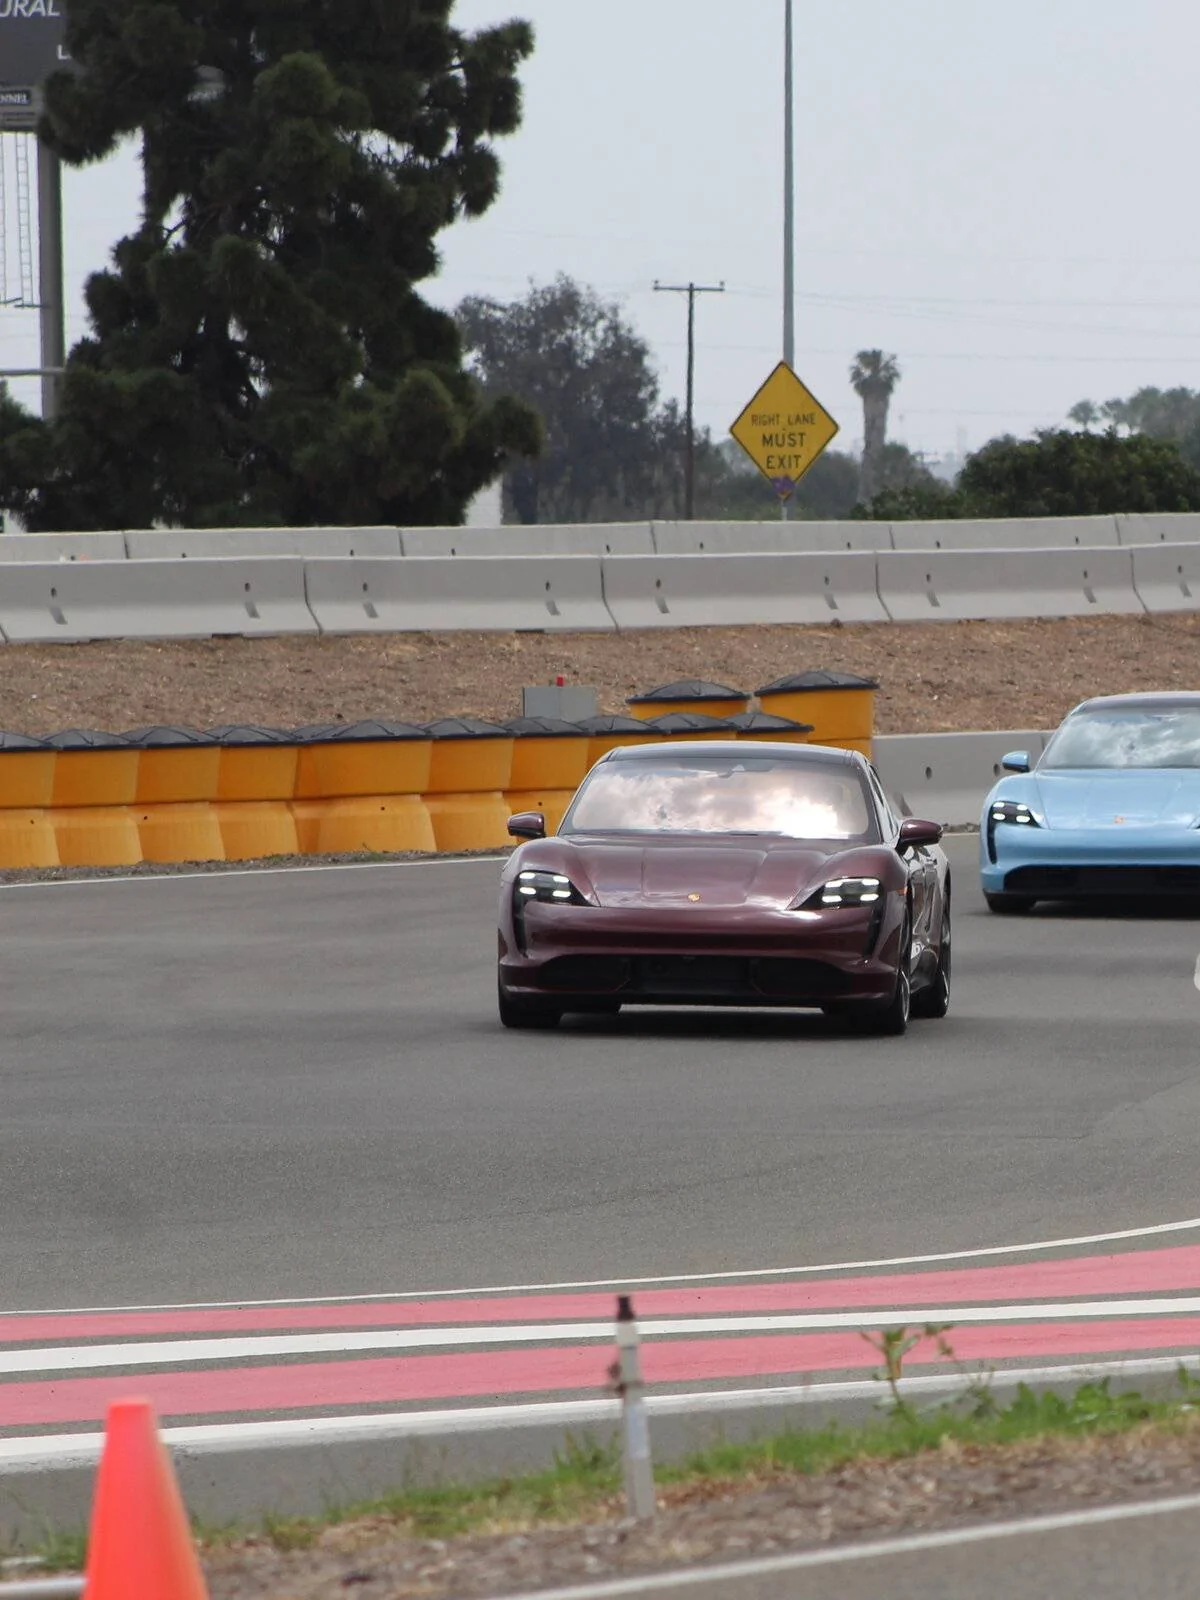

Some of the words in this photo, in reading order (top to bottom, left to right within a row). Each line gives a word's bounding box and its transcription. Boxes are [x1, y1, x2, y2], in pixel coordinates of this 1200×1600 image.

[751, 414, 781, 426] RIGHT
[787, 413, 816, 426] LANE
[762, 432, 806, 448] MUST
[766, 455, 801, 470] EXIT
